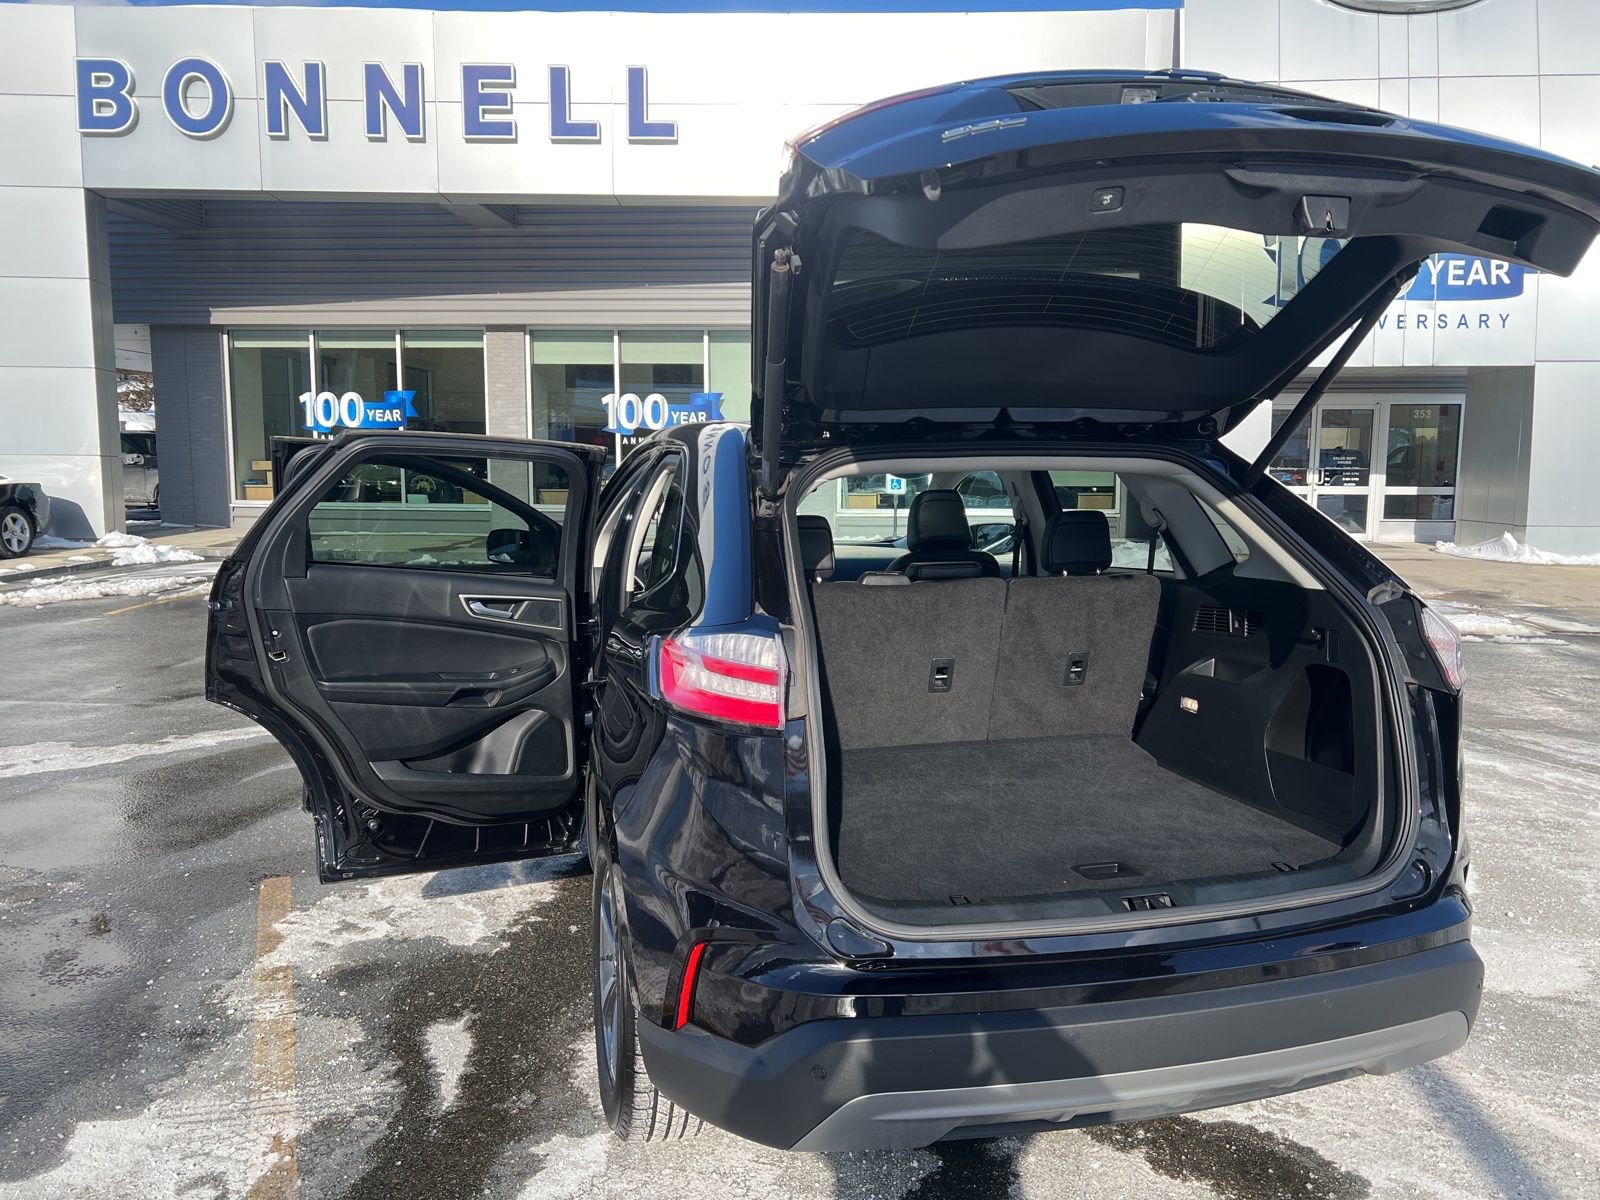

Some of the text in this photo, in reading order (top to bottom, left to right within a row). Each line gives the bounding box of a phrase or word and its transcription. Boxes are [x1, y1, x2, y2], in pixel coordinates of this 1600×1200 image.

[74, 56, 678, 143] BONNELL
[1425, 259, 1511, 286] YEAR
[1377, 313, 1511, 330] VERSARY
[299, 391, 402, 428] 100 YEAR
[601, 393, 707, 430] 100 YEAR
[1413, 409, 1432, 419] 353
